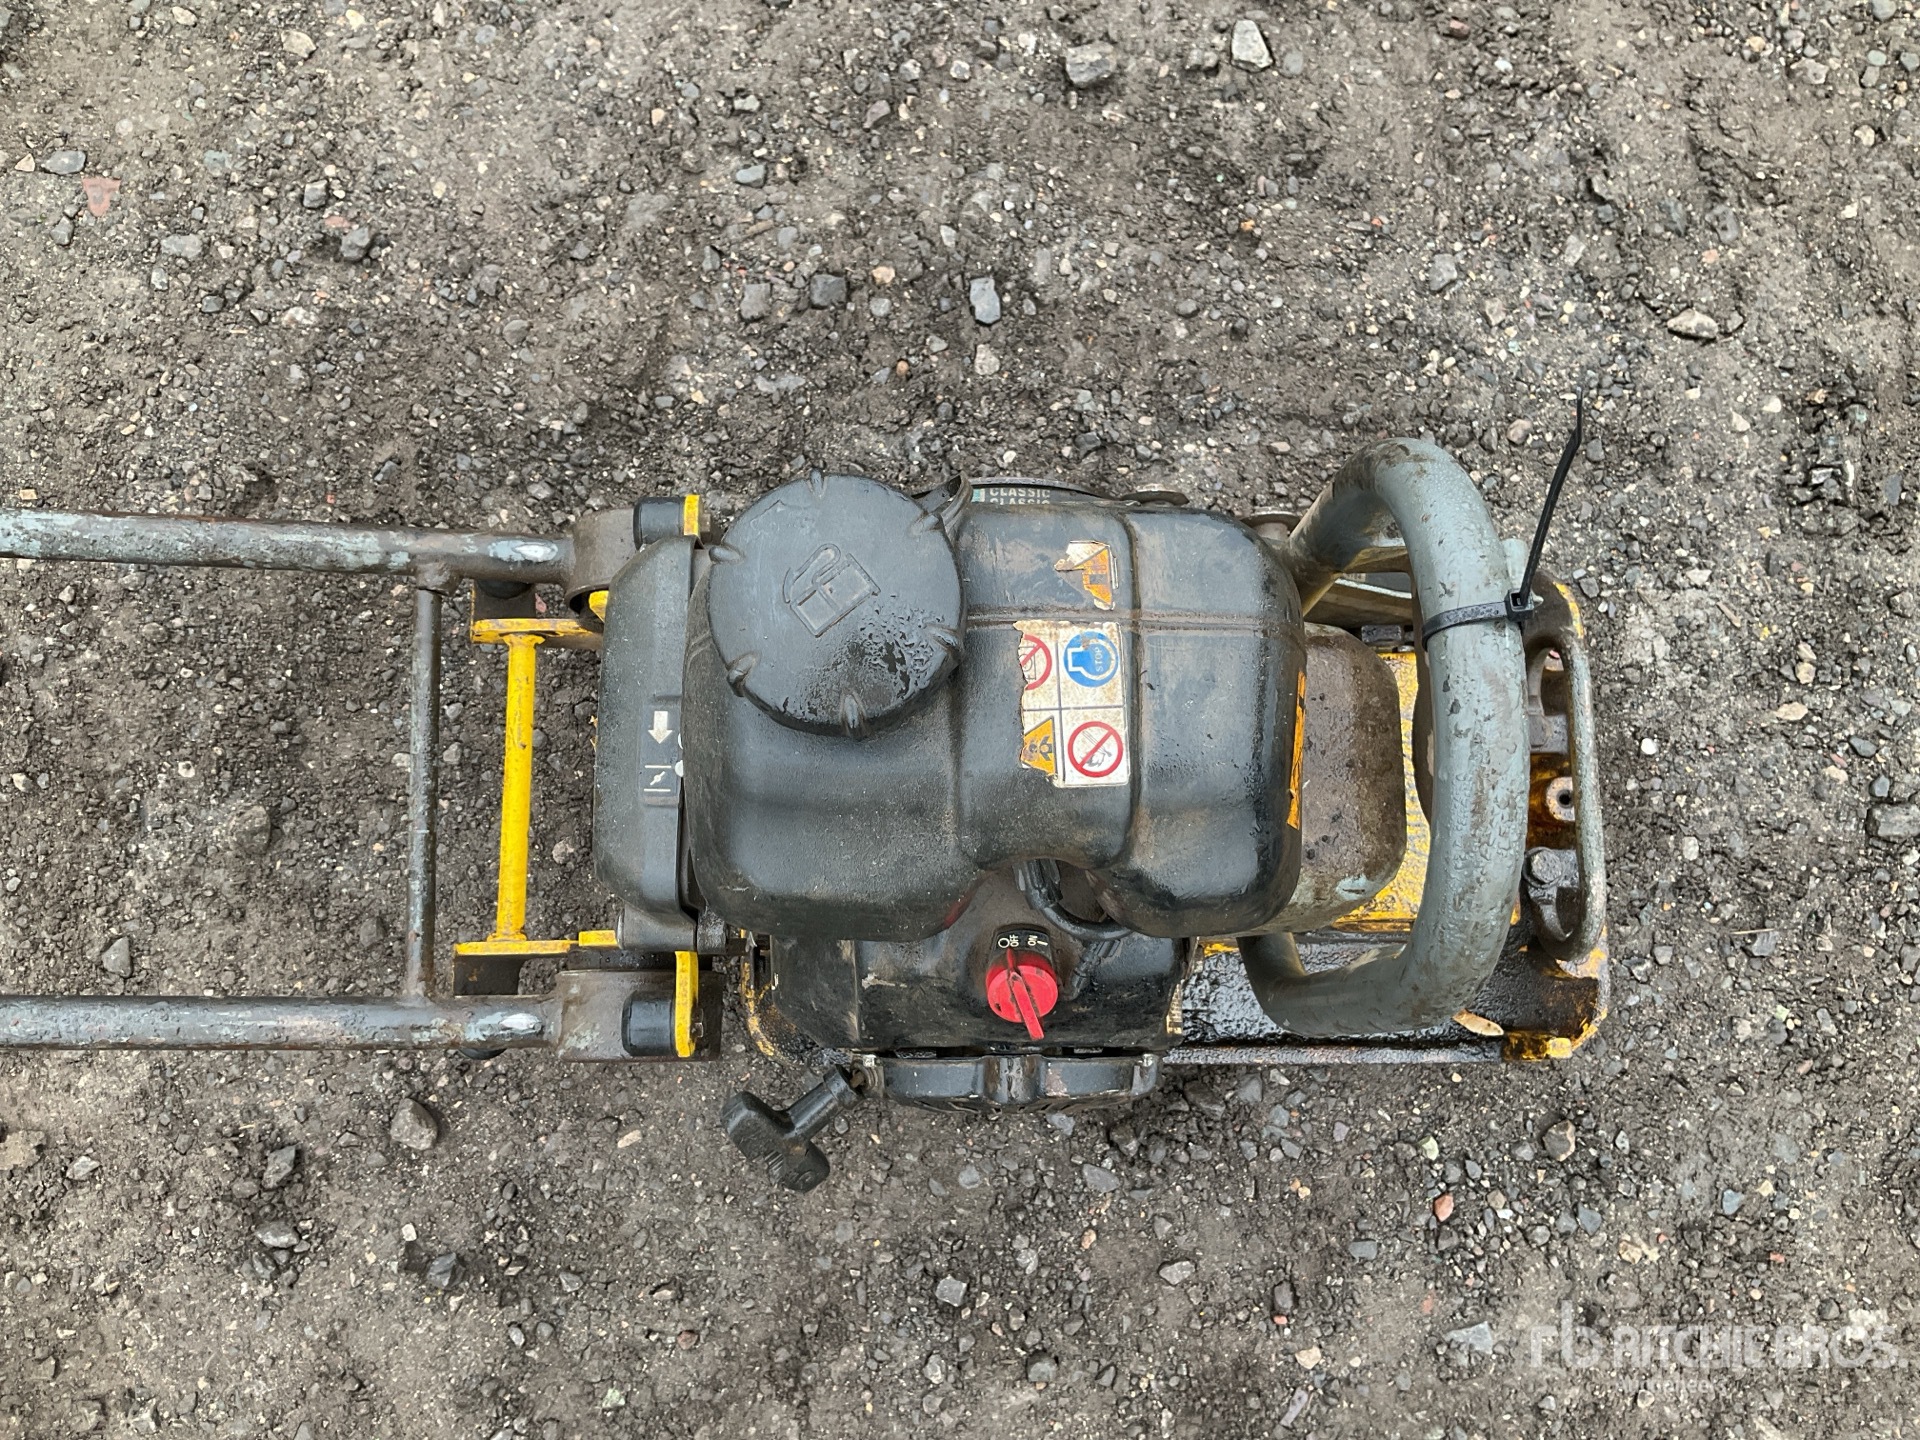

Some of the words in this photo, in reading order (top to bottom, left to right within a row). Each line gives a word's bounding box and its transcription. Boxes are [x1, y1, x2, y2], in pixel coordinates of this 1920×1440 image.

[989, 487, 1051, 498] CLASSIC
[1095, 647, 1104, 672] STOP
[1009, 934, 1019, 947] OFF
